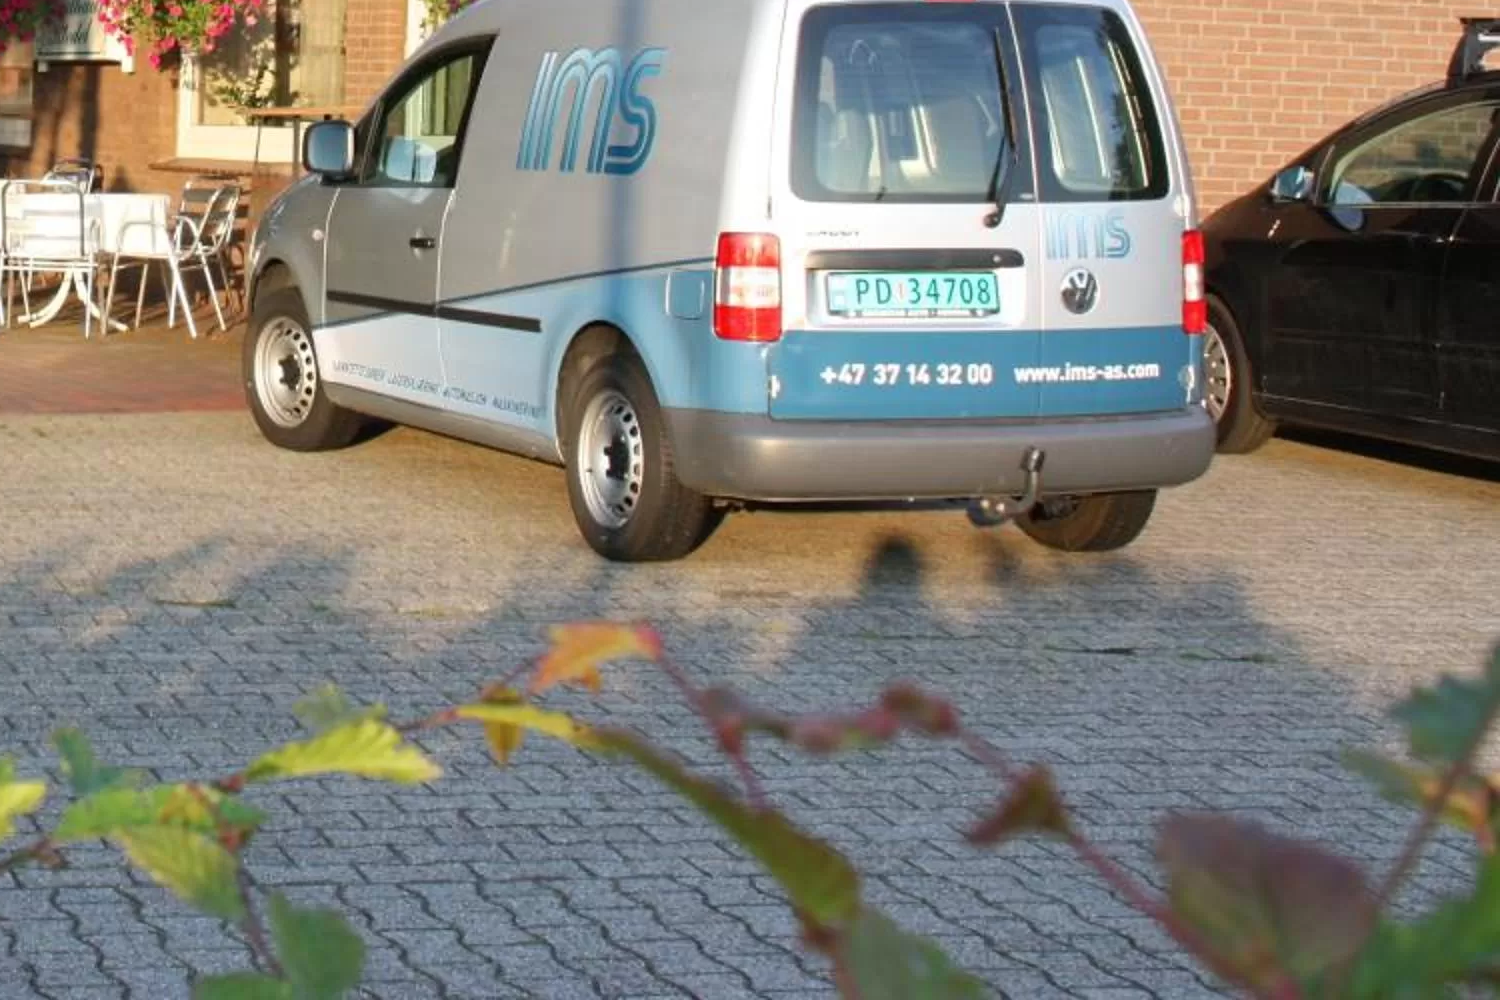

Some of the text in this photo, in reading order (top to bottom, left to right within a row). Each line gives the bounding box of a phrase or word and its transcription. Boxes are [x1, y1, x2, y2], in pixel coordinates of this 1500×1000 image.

[855, 277, 992, 305] PD 34708
[820, 363, 993, 386] +47 37 14 32 00
[1013, 362, 1161, 383] www.ims-as.com
